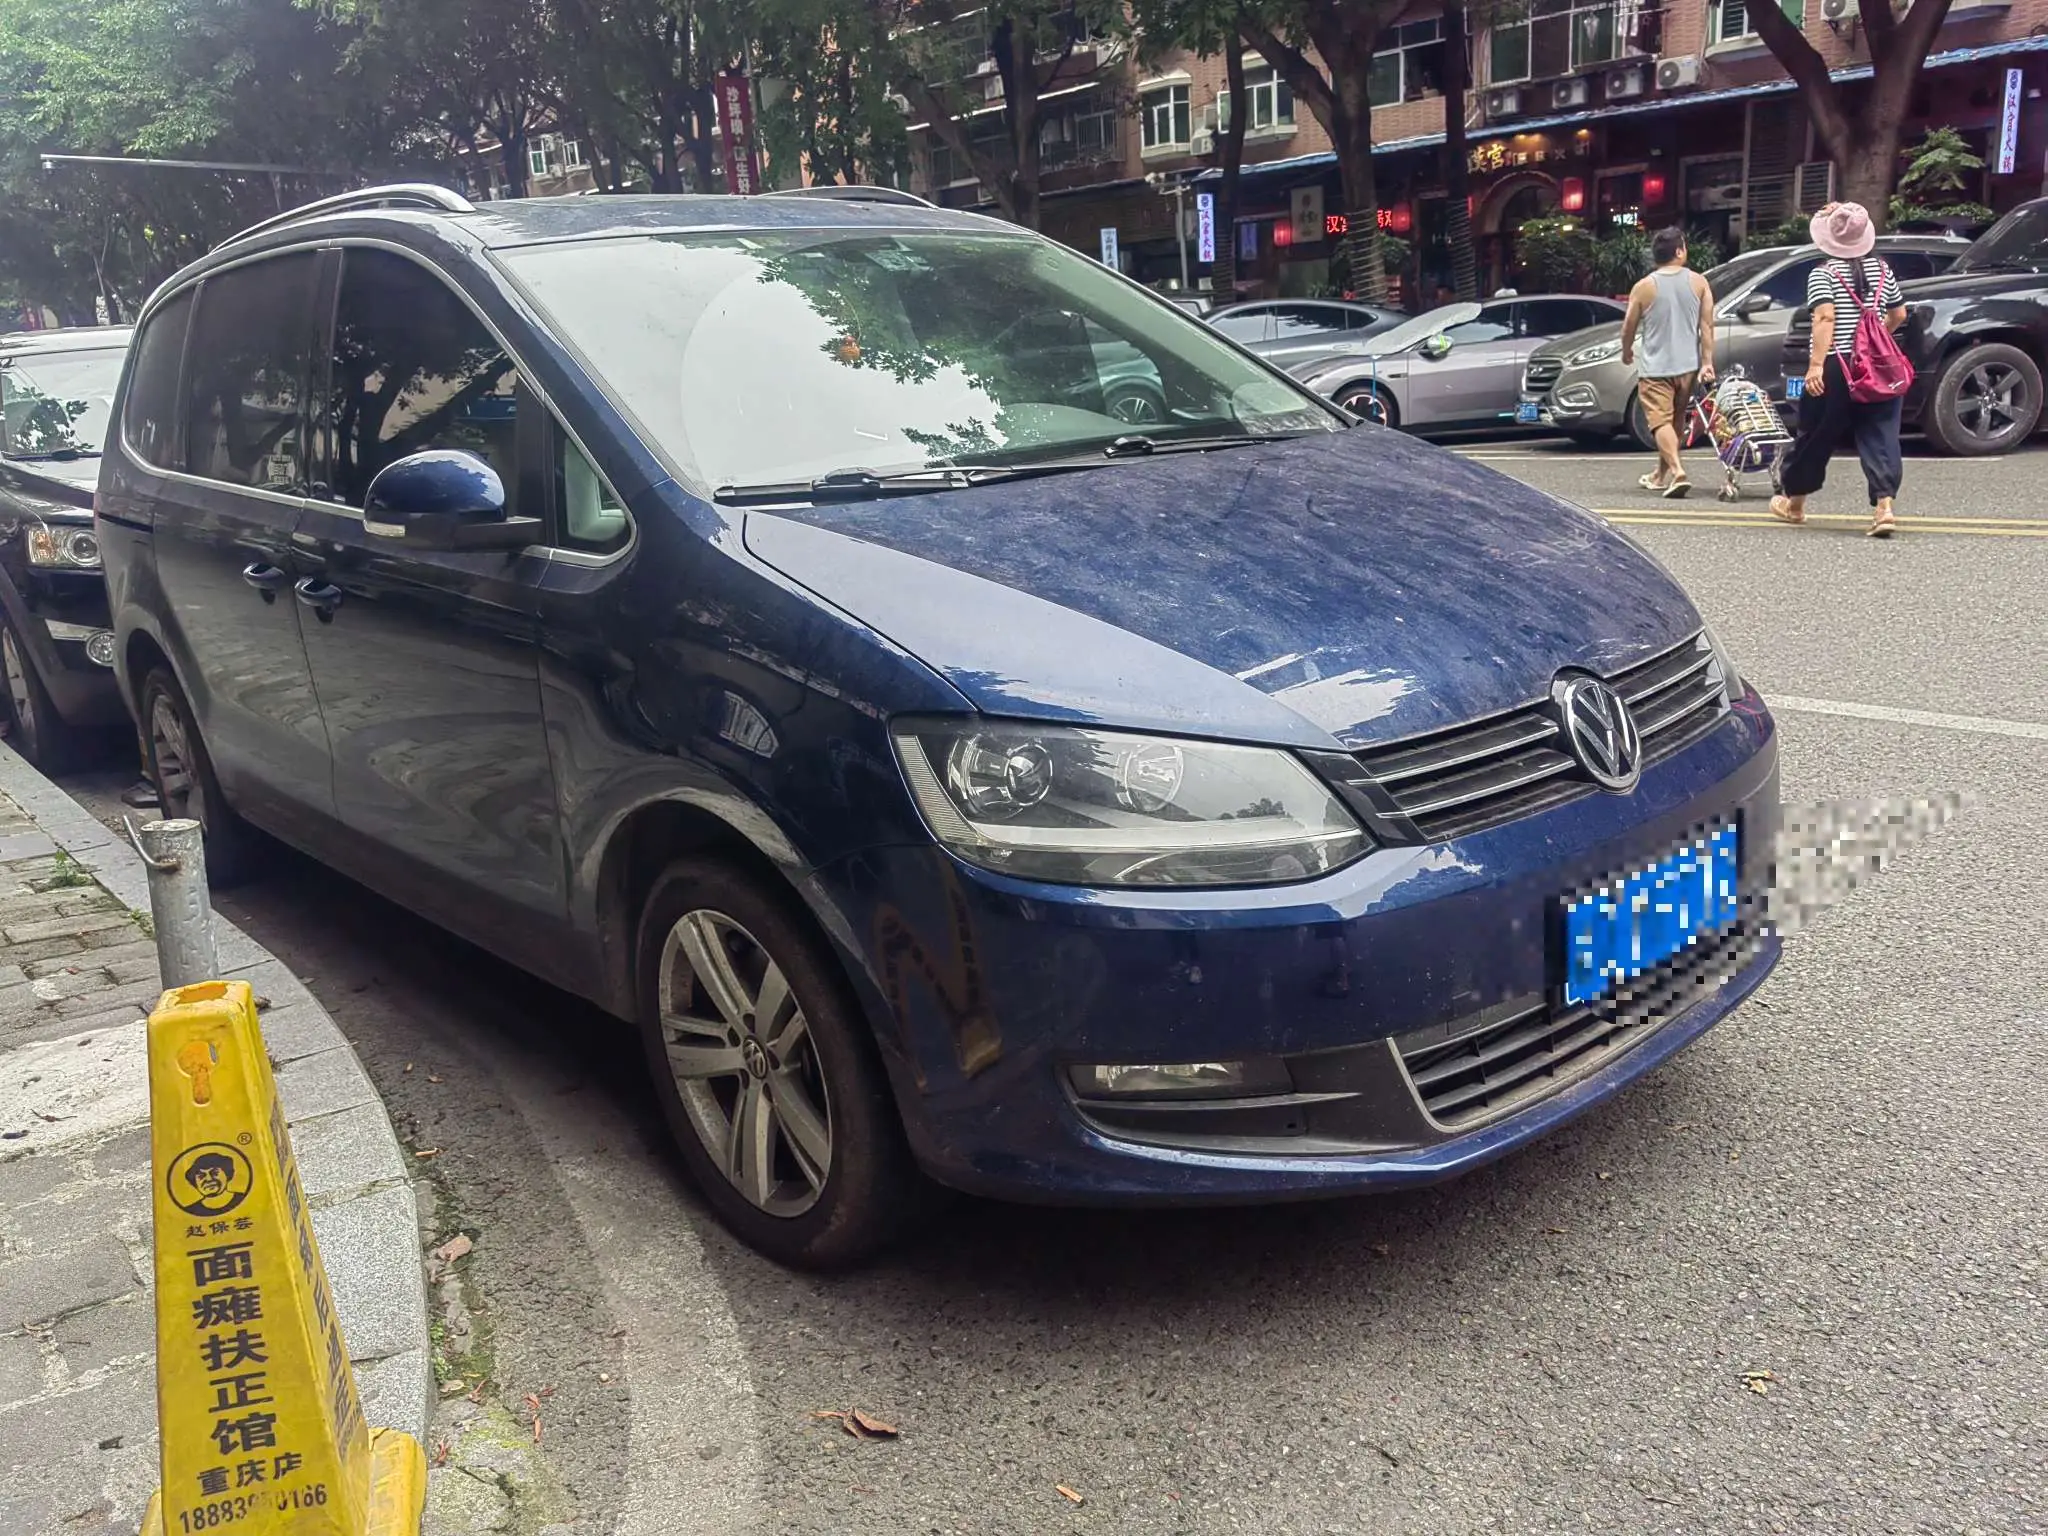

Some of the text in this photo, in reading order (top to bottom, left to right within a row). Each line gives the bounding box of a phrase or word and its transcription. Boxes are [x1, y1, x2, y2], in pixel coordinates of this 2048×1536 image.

[186, 1241, 277, 1456] 面瘫扶正馆
[196, 1452, 302, 1497] 重庆店
[179, 1483, 328, 1534] 188830166
